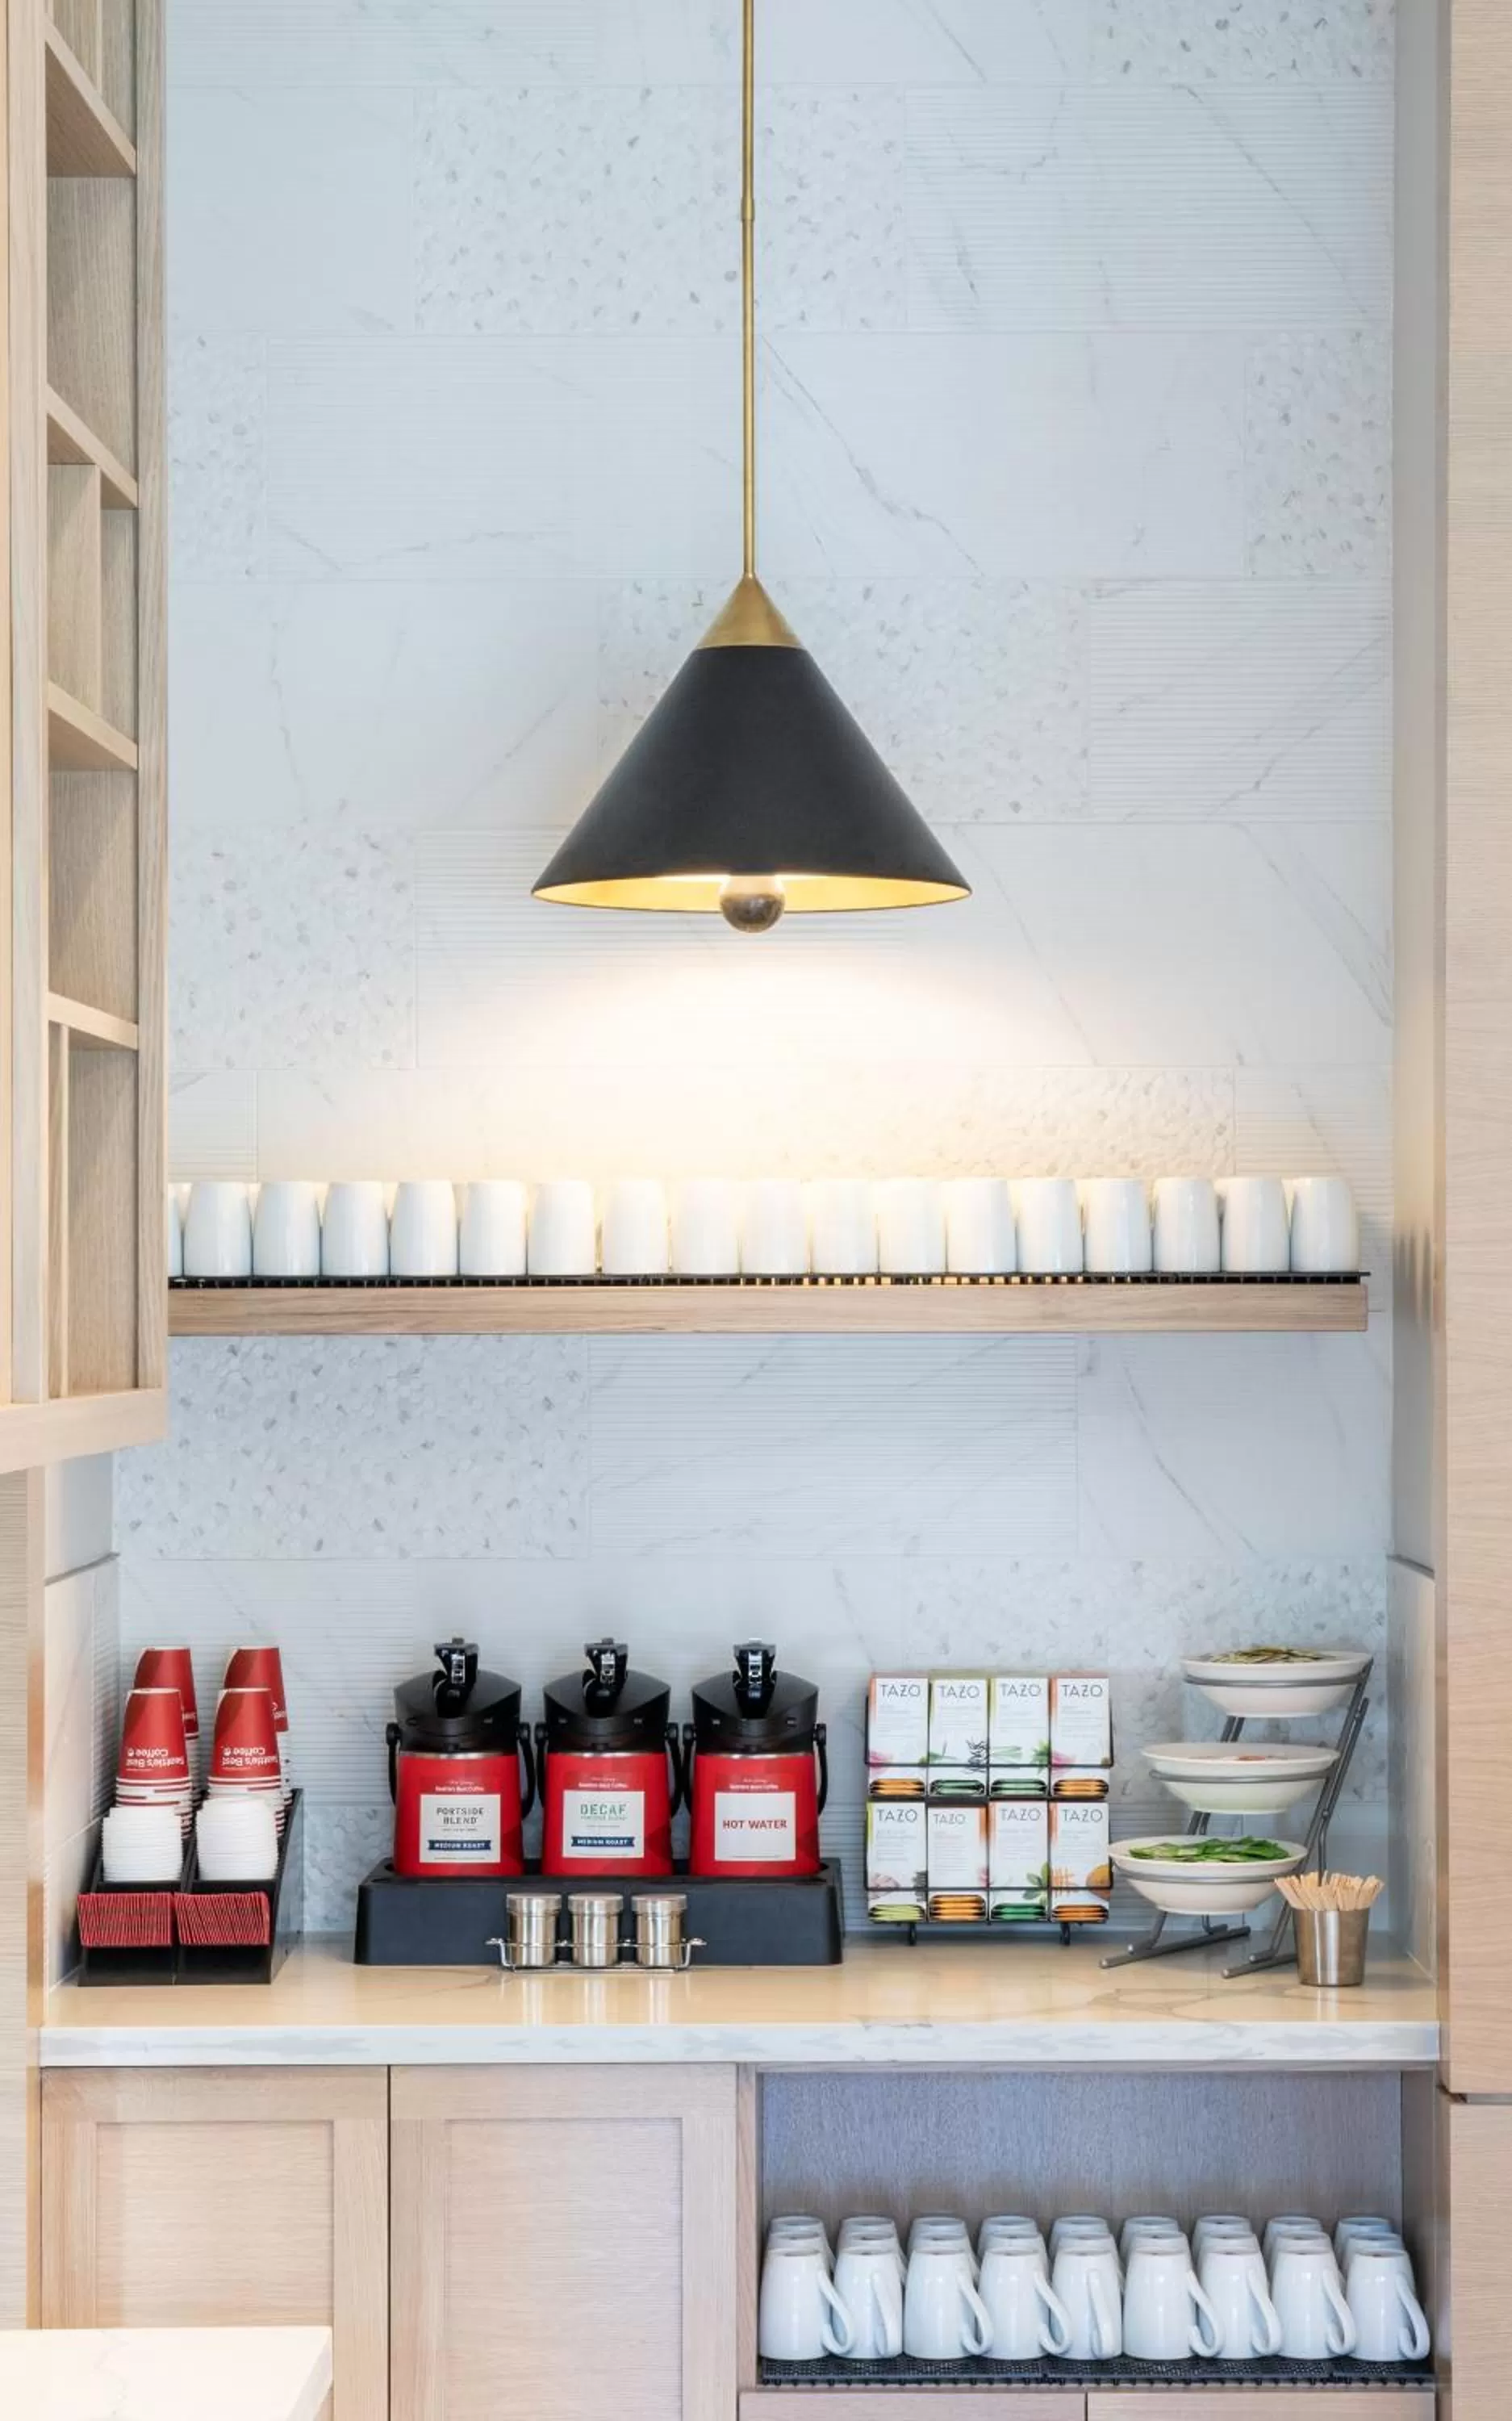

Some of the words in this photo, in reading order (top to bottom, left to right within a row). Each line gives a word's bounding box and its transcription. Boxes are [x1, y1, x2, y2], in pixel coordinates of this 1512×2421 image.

[880, 1683, 921, 1698] TAZO
[938, 1684, 980, 1699] TAZO
[1000, 1683, 1042, 1697] TAZO
[1060, 1683, 1103, 1698] TAZO
[135, 1748, 169, 1758] Coffee
[233, 1747, 265, 1757] Coffee
[222, 1757, 243, 1767] Best
[436, 1807, 484, 1815] PORTSIDE
[580, 1804, 627, 1815] DECAF
[877, 1808, 918, 1823] TAZO
[1000, 1807, 1042, 1821] TAZO
[1061, 1808, 1103, 1822] TAZO
[443, 1817, 478, 1825] BLEND
[722, 1820, 745, 1829] HOT
[748, 1820, 788, 1829] WATER
[933, 1813, 967, 1825] TAZO
